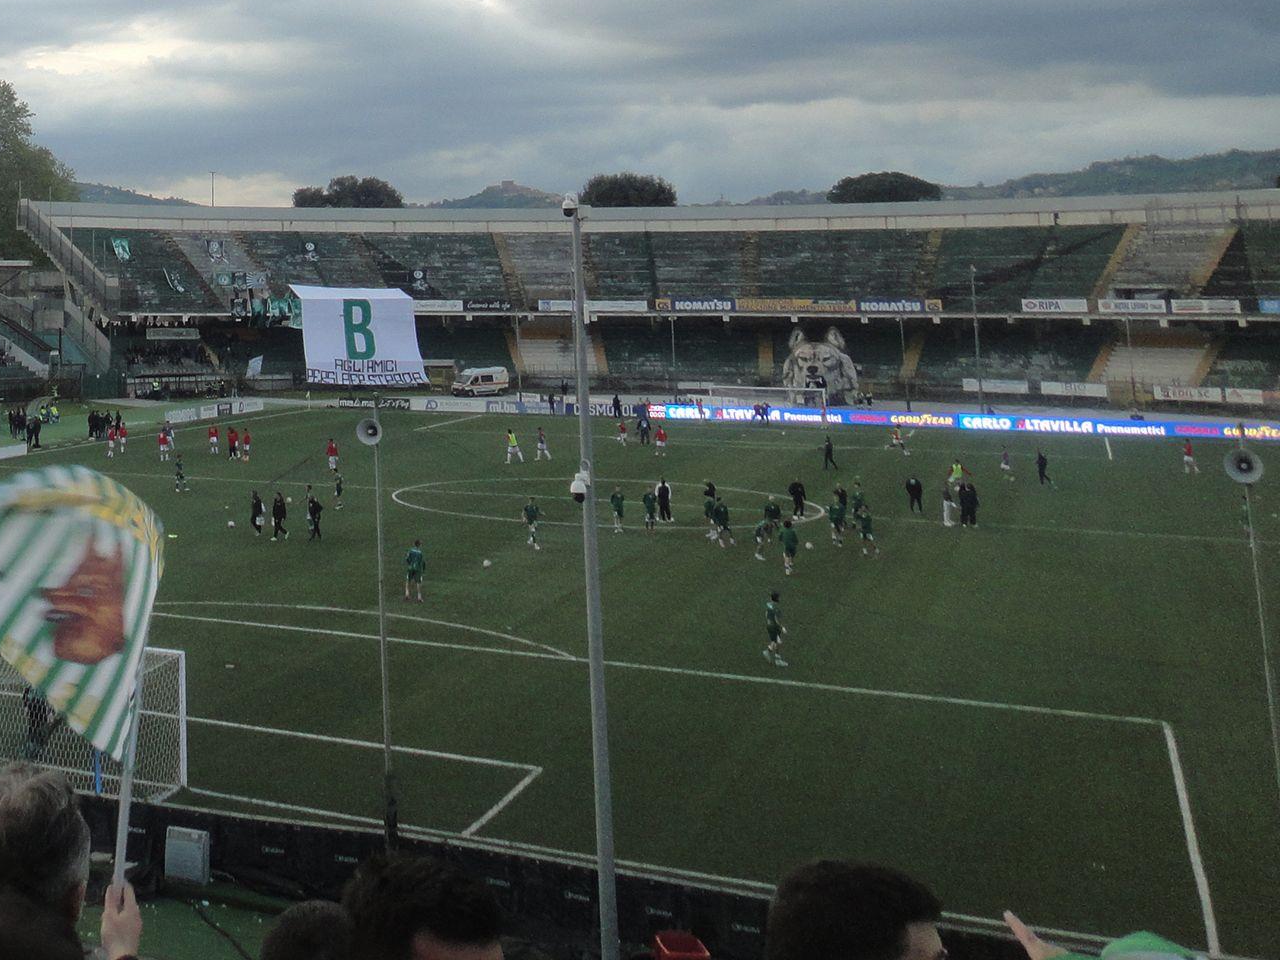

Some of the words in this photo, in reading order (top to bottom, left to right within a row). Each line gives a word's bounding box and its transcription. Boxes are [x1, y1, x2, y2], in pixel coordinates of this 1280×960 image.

[675, 299, 732, 311] KOMATSU
[860, 301, 921, 312] KOMATSU
[342, 298, 377, 360] B
[367, 359, 397, 373] AMICI
[574, 404, 637, 416] CSMOOL
[890, 414, 953, 425] GOODYEAR
[962, 416, 1011, 430] CARLO
[1017, 419, 1094, 433] ALTAVILLA
